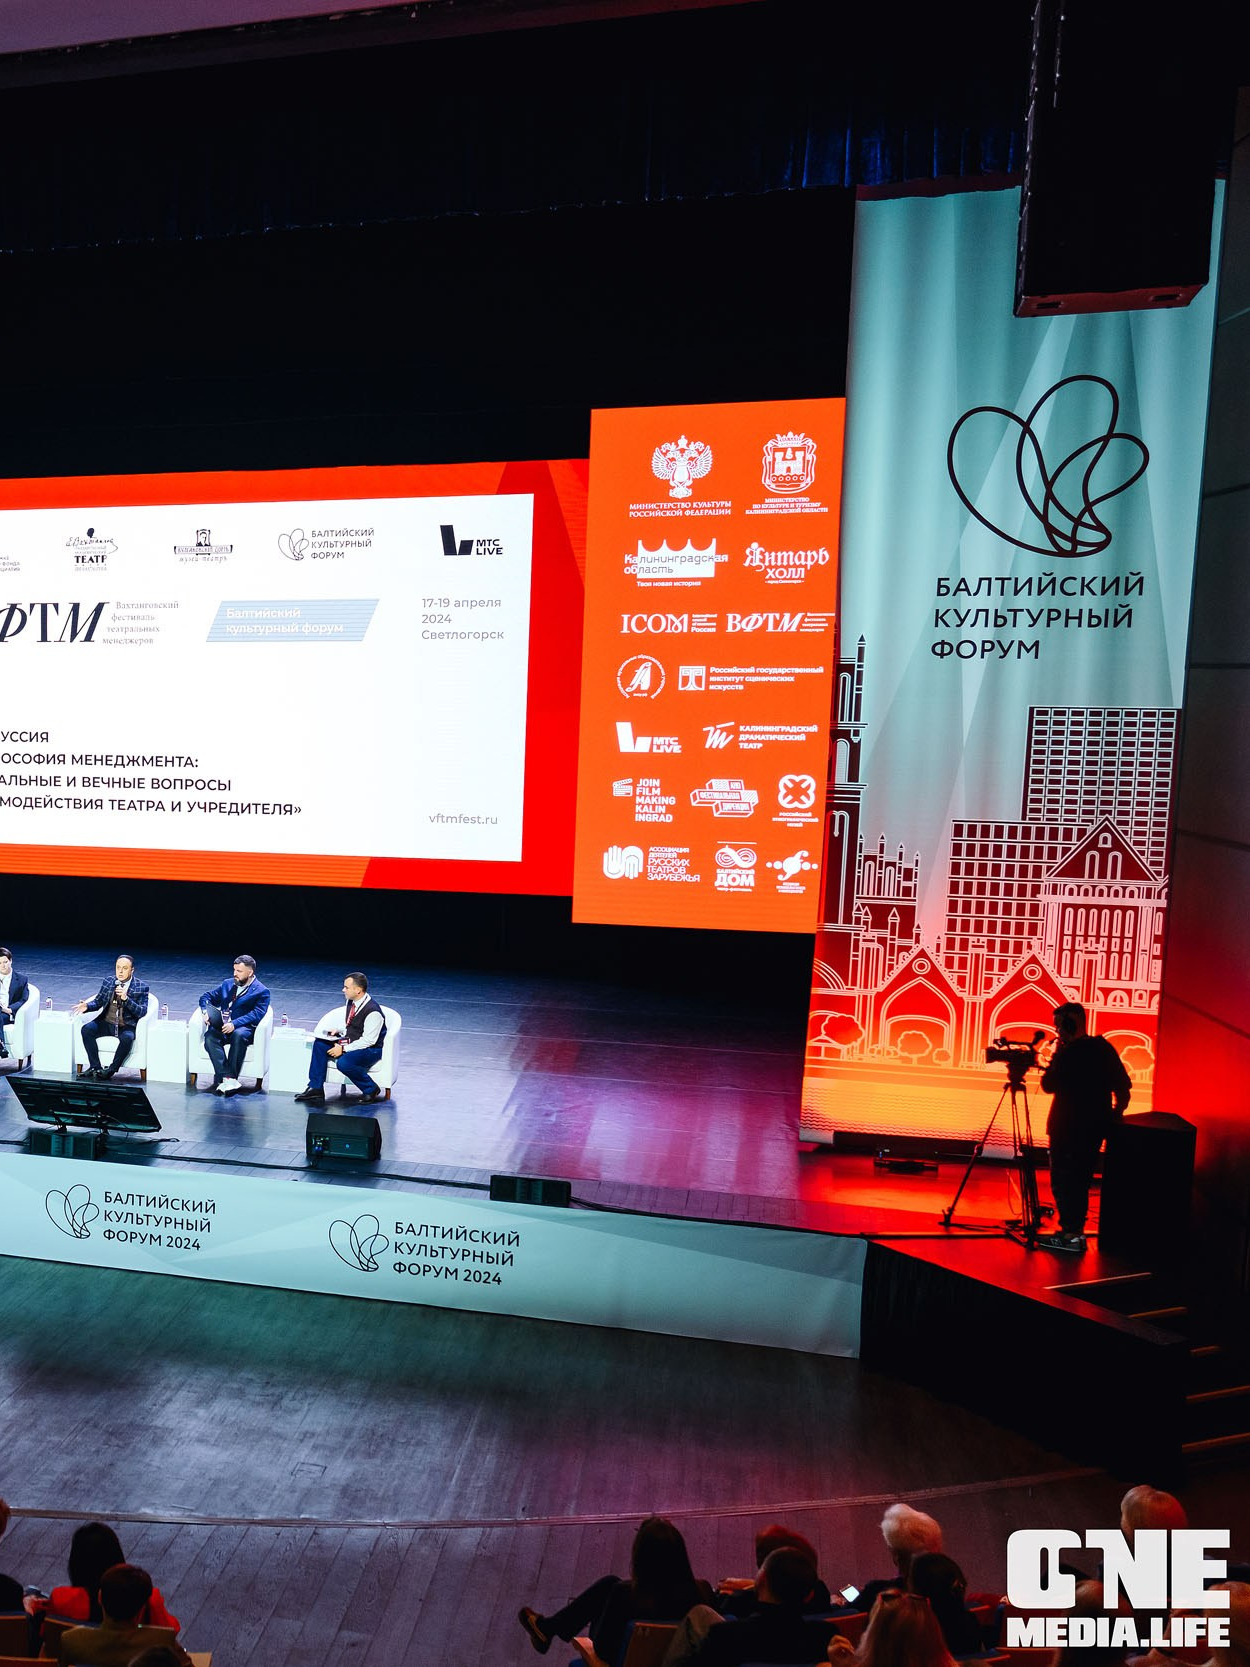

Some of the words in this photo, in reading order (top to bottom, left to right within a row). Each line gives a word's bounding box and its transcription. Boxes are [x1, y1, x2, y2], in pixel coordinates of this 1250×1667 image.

[629, 502, 691, 510] МИНИСТЕРСТВО
[693, 501, 732, 509] КУЛЬТУРЫ
[629, 509, 683, 517] РОССИЙСКОЙ
[684, 508, 732, 516] ФЕДЕРАЦИИ
[311, 527, 375, 538] БАЛТИЙСКИЙ
[311, 538, 372, 549] КУЛЬТУРНЫЙ
[310, 551, 345, 560] ФОРУМ
[476, 547, 503, 555] LIVE
[73, 554, 108, 564] ТЕАТР
[624, 553, 729, 566] Калининградская
[624, 565, 674, 575] область
[765, 567, 805, 579] ХОЛЛ
[936, 571, 1145, 597] БАЛТИЙСКИЙ
[116, 600, 179, 609] Вахтанговский
[421, 598, 450, 608] 17-19
[453, 599, 502, 610] апреля
[111, 613, 155, 622] фестиваль
[226, 607, 301, 618] Балтийский
[934, 603, 1133, 628] КУЛЬТУРНЫЙ
[421, 613, 452, 624] 2024
[620, 613, 688, 633] ICOM
[726, 612, 805, 633] ВФТМ
[106, 625, 160, 633] театральных
[226, 623, 299, 636] культурный
[301, 623, 344, 636] форум
[421, 629, 504, 641] Светлогорск
[102, 637, 154, 646] менеджеров
[930, 639, 1040, 660] ФОРУМ
[709, 665, 755, 674] Российский
[756, 666, 824, 674] государственный
[709, 675, 744, 683] институт
[739, 725, 818, 733] КАЛИНИНГРАДСКИЙ
[739, 733, 806, 741] ДРАМАТИЧЕСКИЙ
[653, 745, 682, 753] LIVE
[71, 754, 199, 769] МЕНЕДЖМЕНТА:
[66, 776, 76, 787] И
[82, 776, 146, 789] ВЕЧНЫЕ
[150, 778, 232, 791] ВОПРОСЫ
[637, 778, 660, 787] JOIN
[636, 787, 661, 795] FILM
[636, 796, 676, 805] MAKING
[108, 799, 166, 812] ТЕАТРА
[170, 801, 181, 812] И
[186, 801, 302, 817] УЧРЕДИТЕЛЯ»
[635, 805, 666, 814] KALIN
[428, 812, 498, 825] vftmfest.ru
[635, 813, 673, 823] INGRAD
[648, 857, 690, 867] РУССКИХ
[646, 865, 686, 874] ТЕАТРОВ
[647, 873, 701, 883] ЗАРУБЕЖЬЯ
[714, 873, 755, 887] ДОМ
[103, 1190, 217, 1215] БАЛТИЙСКИЙ
[103, 1209, 212, 1233] КУЛЬТУРНЫЙ
[102, 1228, 163, 1249] ФОРУМ
[165, 1235, 201, 1251] 2024
[394, 1221, 521, 1248] БАЛТИЙСКИЙ
[393, 1241, 515, 1267] КУЛЬТУРНЫЙ
[392, 1260, 459, 1282] ФОРУМ
[463, 1268, 503, 1286] 2024
